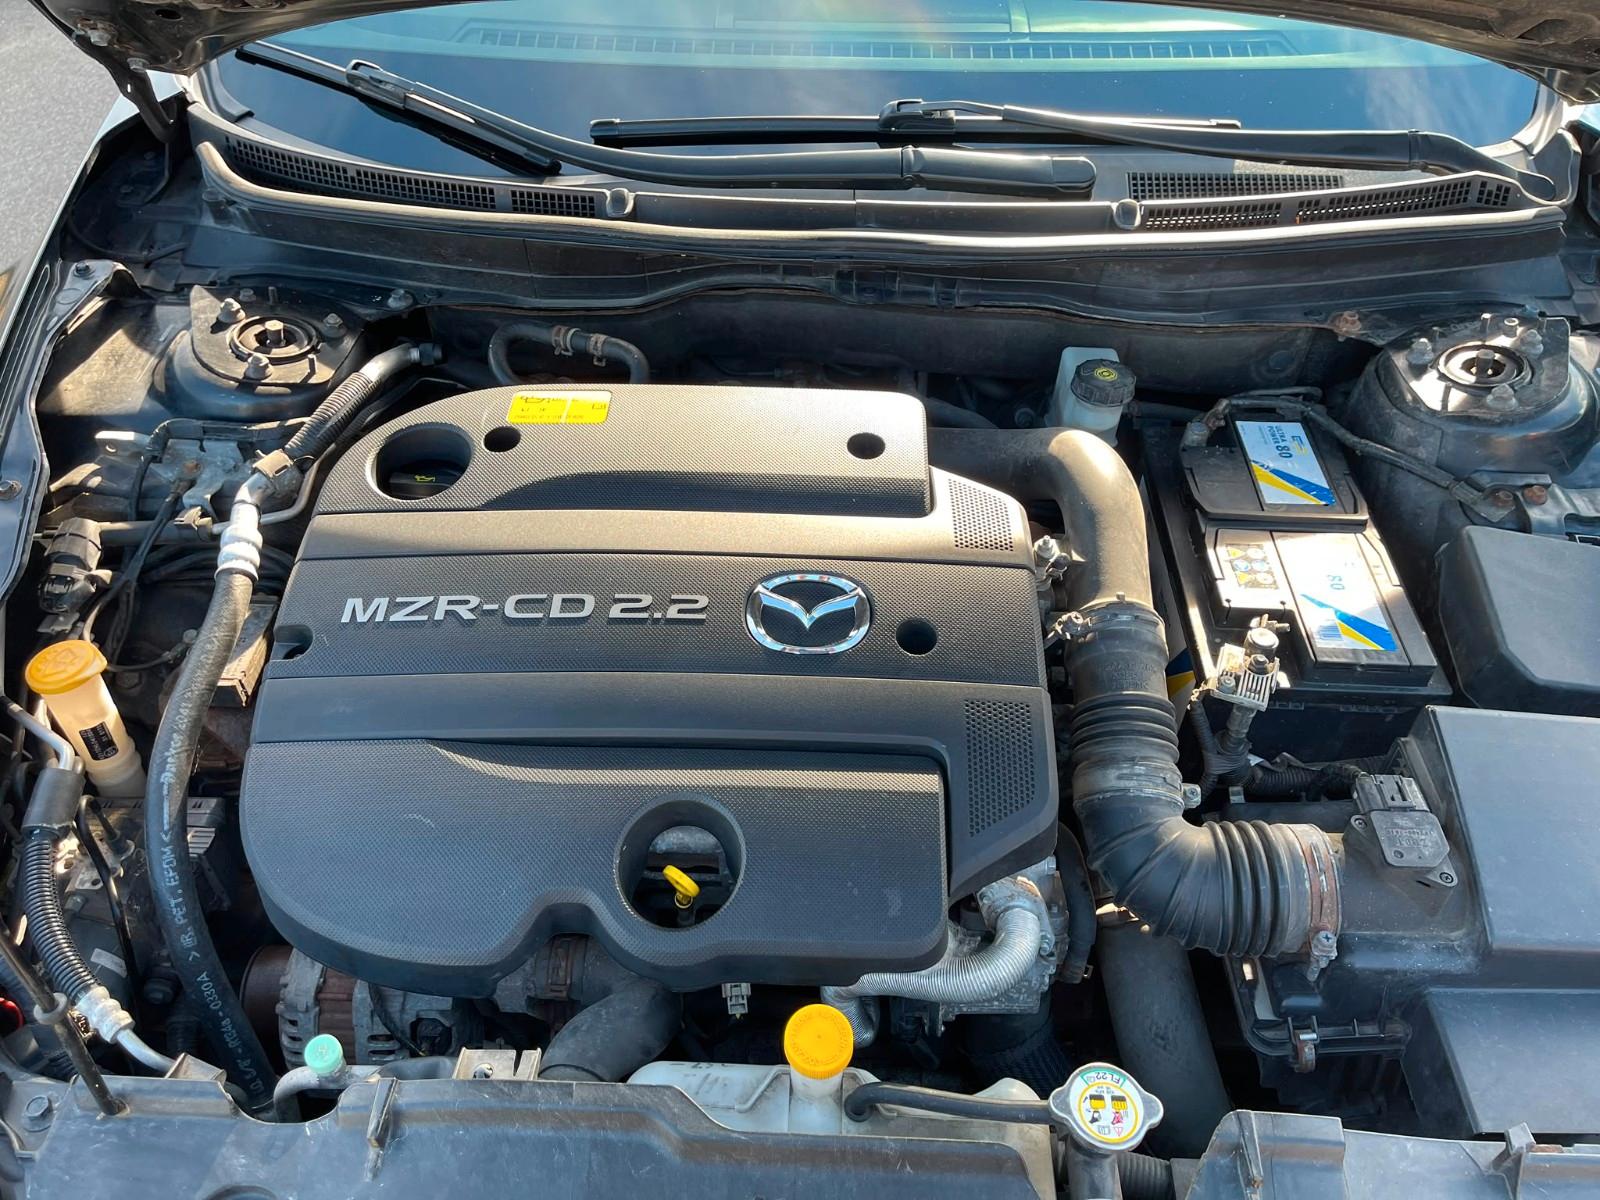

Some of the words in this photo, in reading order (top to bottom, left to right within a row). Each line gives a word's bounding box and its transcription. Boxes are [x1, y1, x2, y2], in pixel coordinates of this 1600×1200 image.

[1275, 444, 1294, 459] 80
[341, 593, 596, 623] MZR-CD
[607, 593, 710, 621] 2.2
[1096, 1072, 1121, 1084] FL22
